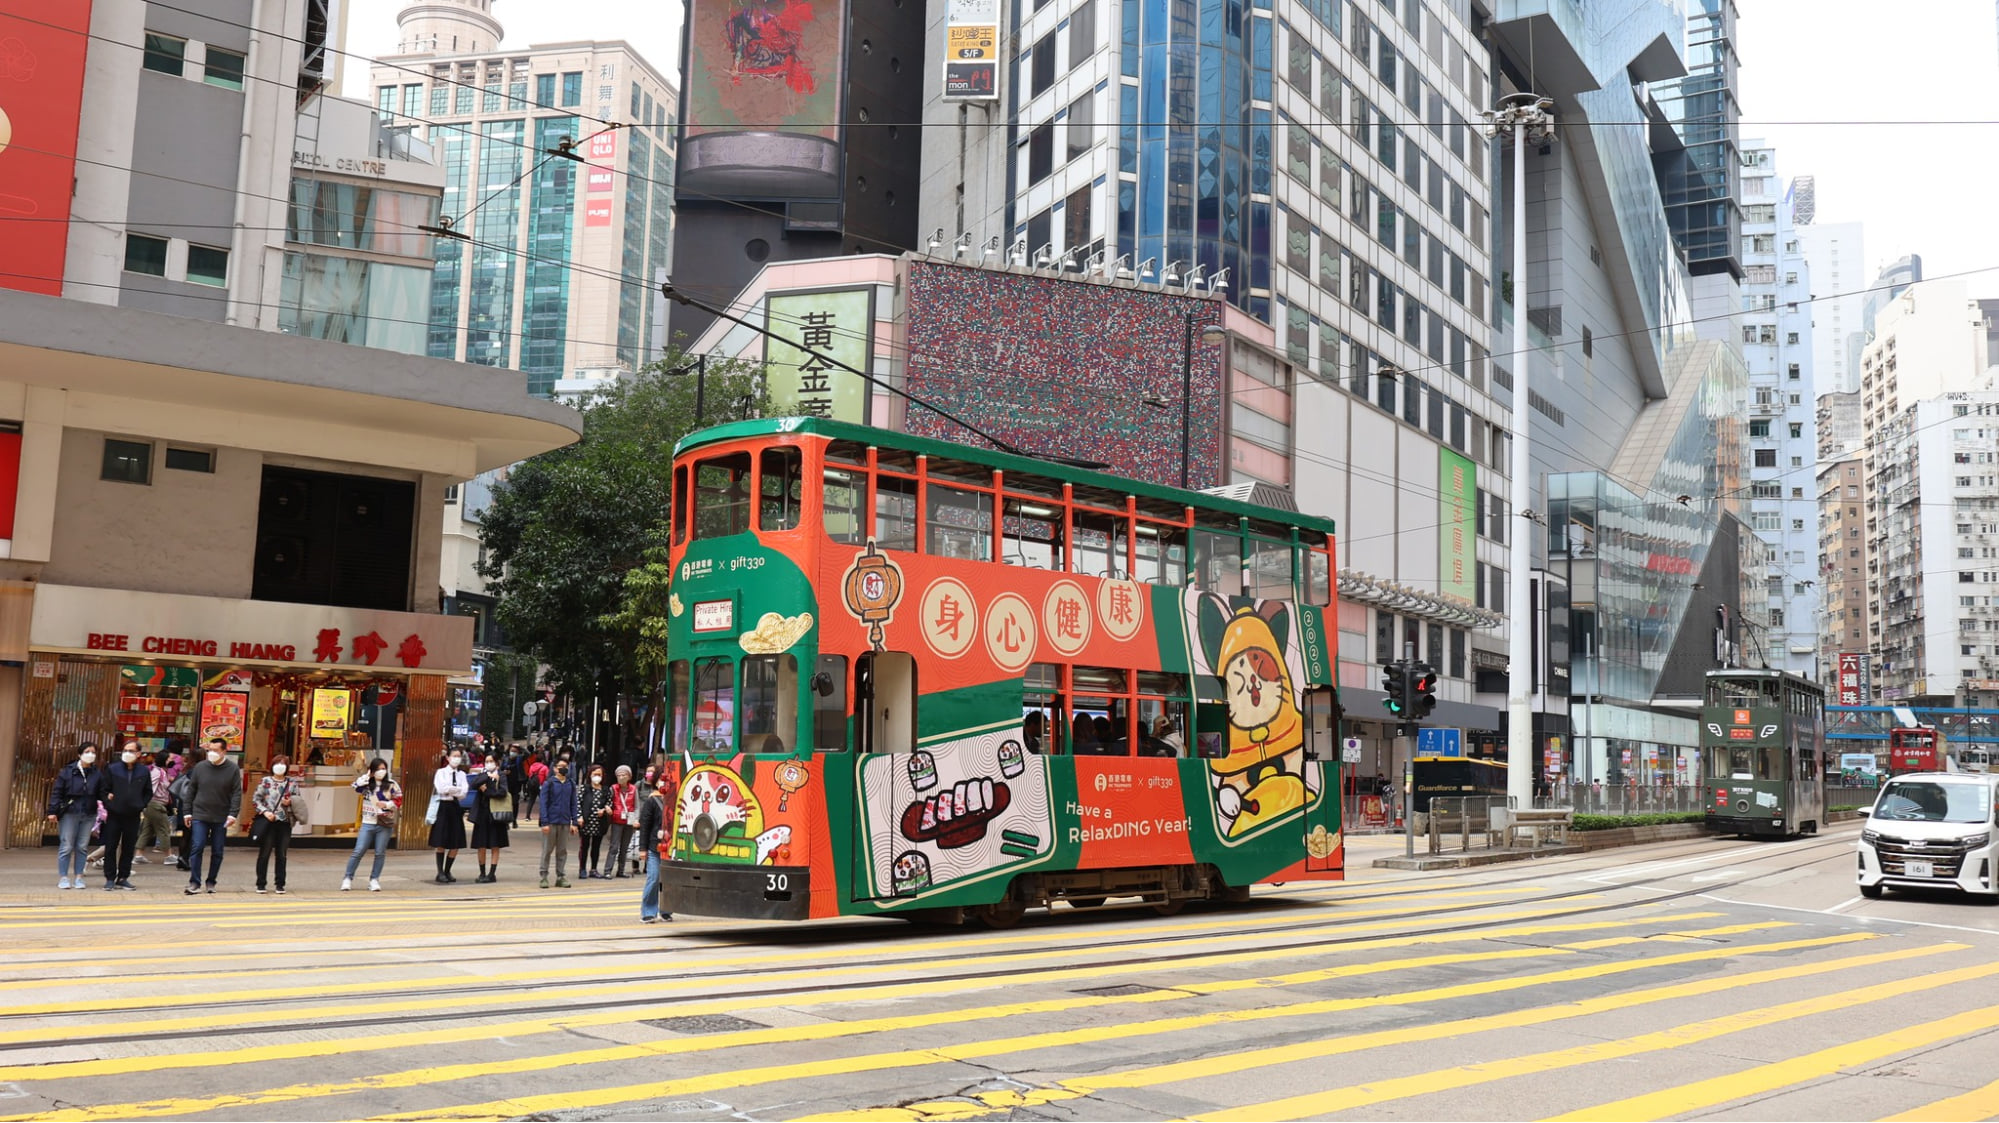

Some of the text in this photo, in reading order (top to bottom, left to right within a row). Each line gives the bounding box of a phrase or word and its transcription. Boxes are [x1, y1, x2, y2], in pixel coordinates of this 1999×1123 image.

[963, 50, 978, 58] 5/F
[593, 134, 612, 144] UNI
[592, 145, 613, 156] QLO
[336, 158, 386, 175] CENTRE
[590, 174, 612, 184] MUJI
[776, 419, 795, 432] 30
[730, 555, 766, 571] gift330
[695, 602, 732, 615] Private Hire
[935, 584, 1133, 653] 身心健康
[88, 633, 295, 661] BEE CHENG HIANG
[312, 628, 427, 668] 美珍香
[1841, 655, 1857, 722] 六福珠
[1148, 776, 1173, 789] gift330
[1066, 800, 1112, 819] Have a
[1069, 815, 1192, 844] RelaxDING Year!
[1912, 865, 1925, 873] 161
[766, 874, 788, 891] 30
